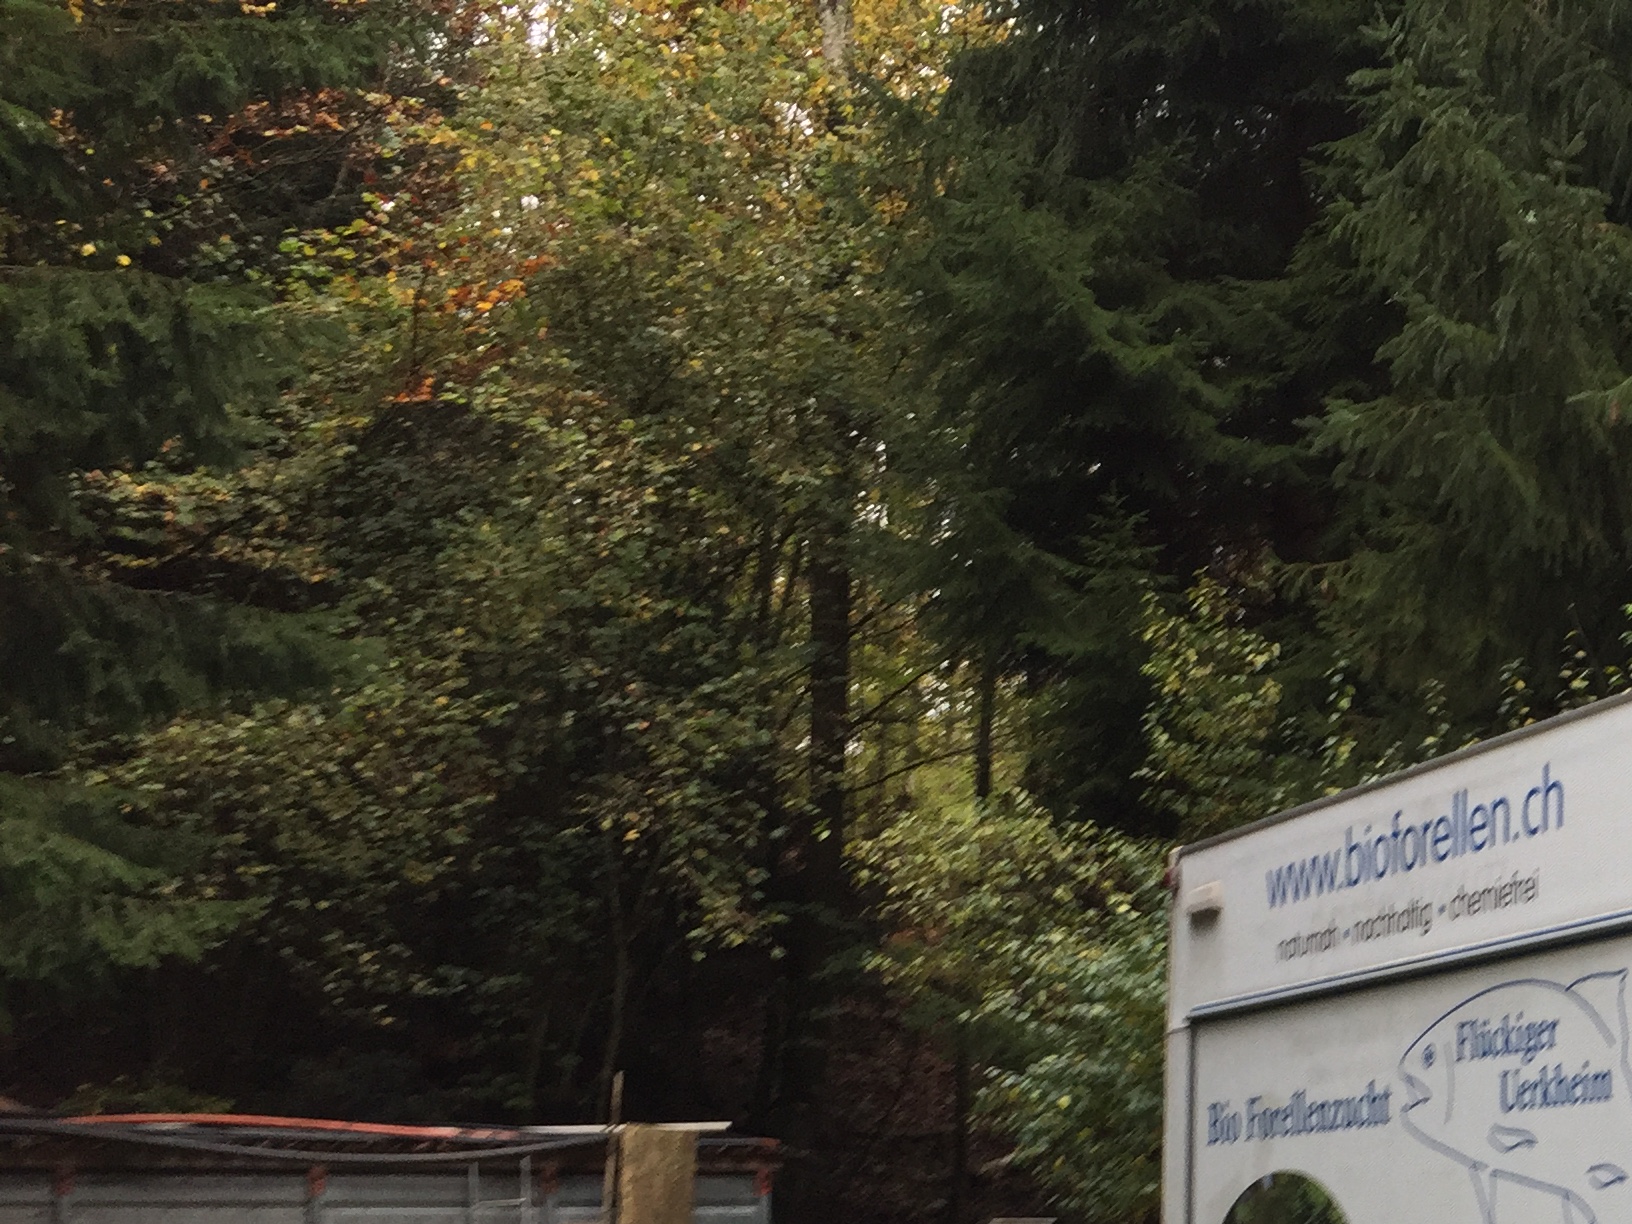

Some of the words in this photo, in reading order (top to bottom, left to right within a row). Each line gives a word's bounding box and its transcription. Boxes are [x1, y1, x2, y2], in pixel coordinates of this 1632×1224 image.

[1266, 761, 1565, 908] www.bioforellen.ch
[1448, 867, 1540, 920] chemiefrei
[1455, 1012, 1561, 1065] Flückiger
[1207, 1098, 1241, 1146] Bio
[1245, 1079, 1393, 1142] Forellenzucht
[1498, 1061, 1613, 1114] Uerkheim
